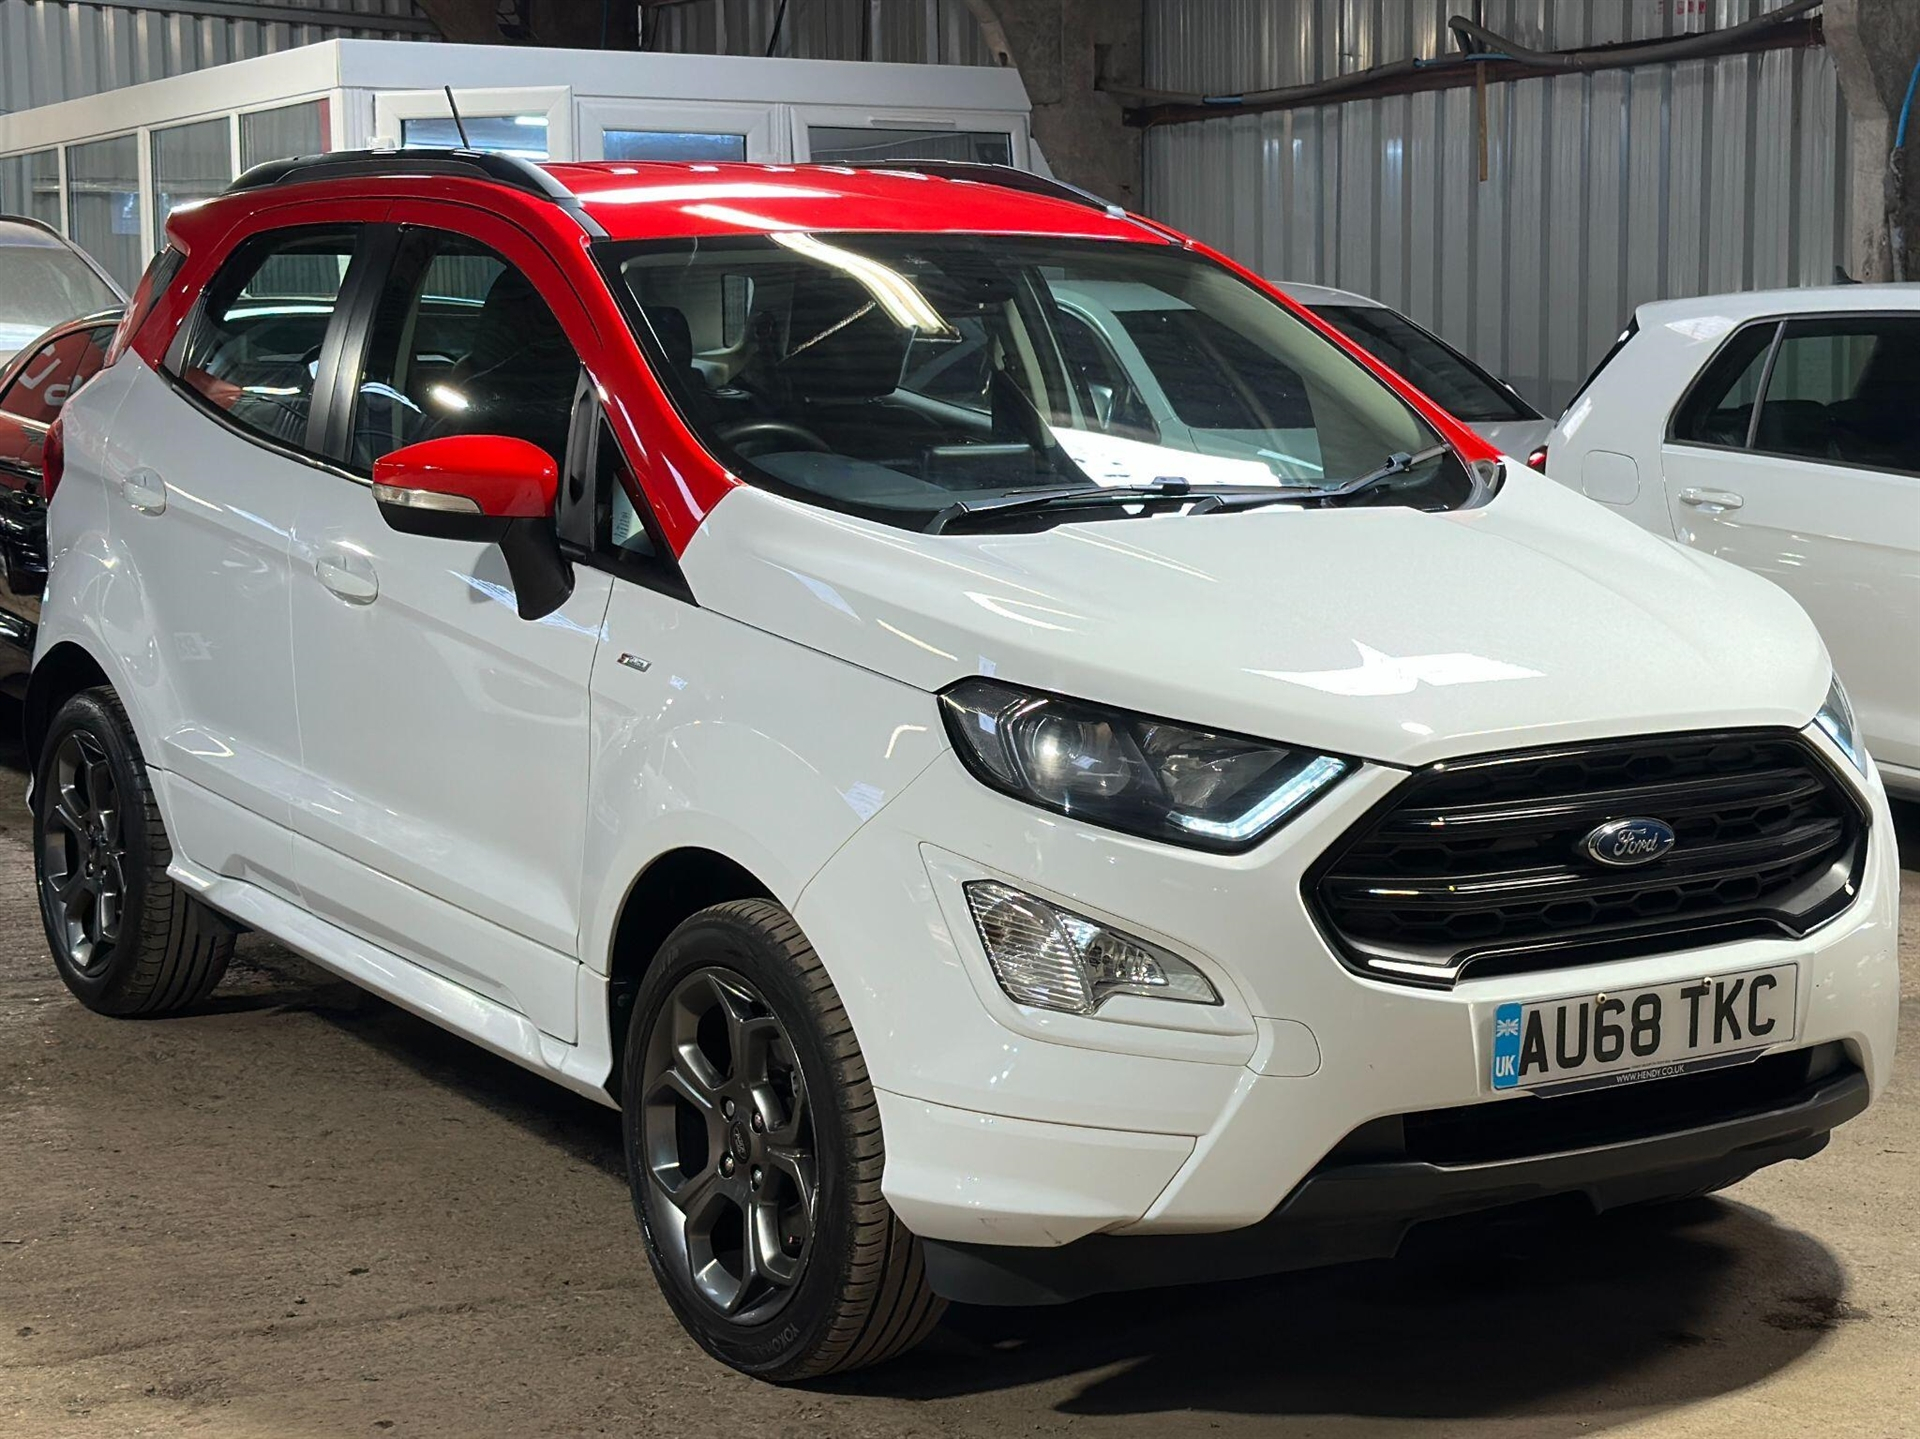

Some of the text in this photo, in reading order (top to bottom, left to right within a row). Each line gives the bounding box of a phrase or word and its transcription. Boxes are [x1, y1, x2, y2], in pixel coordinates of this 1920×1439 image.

[1613, 828, 1659, 857] Ford
[1518, 974, 1777, 1077] AU68 TKC
[1495, 1055, 1516, 1078] UK
[1616, 1064, 1685, 1083] WWW.HENDY.CO.UK
